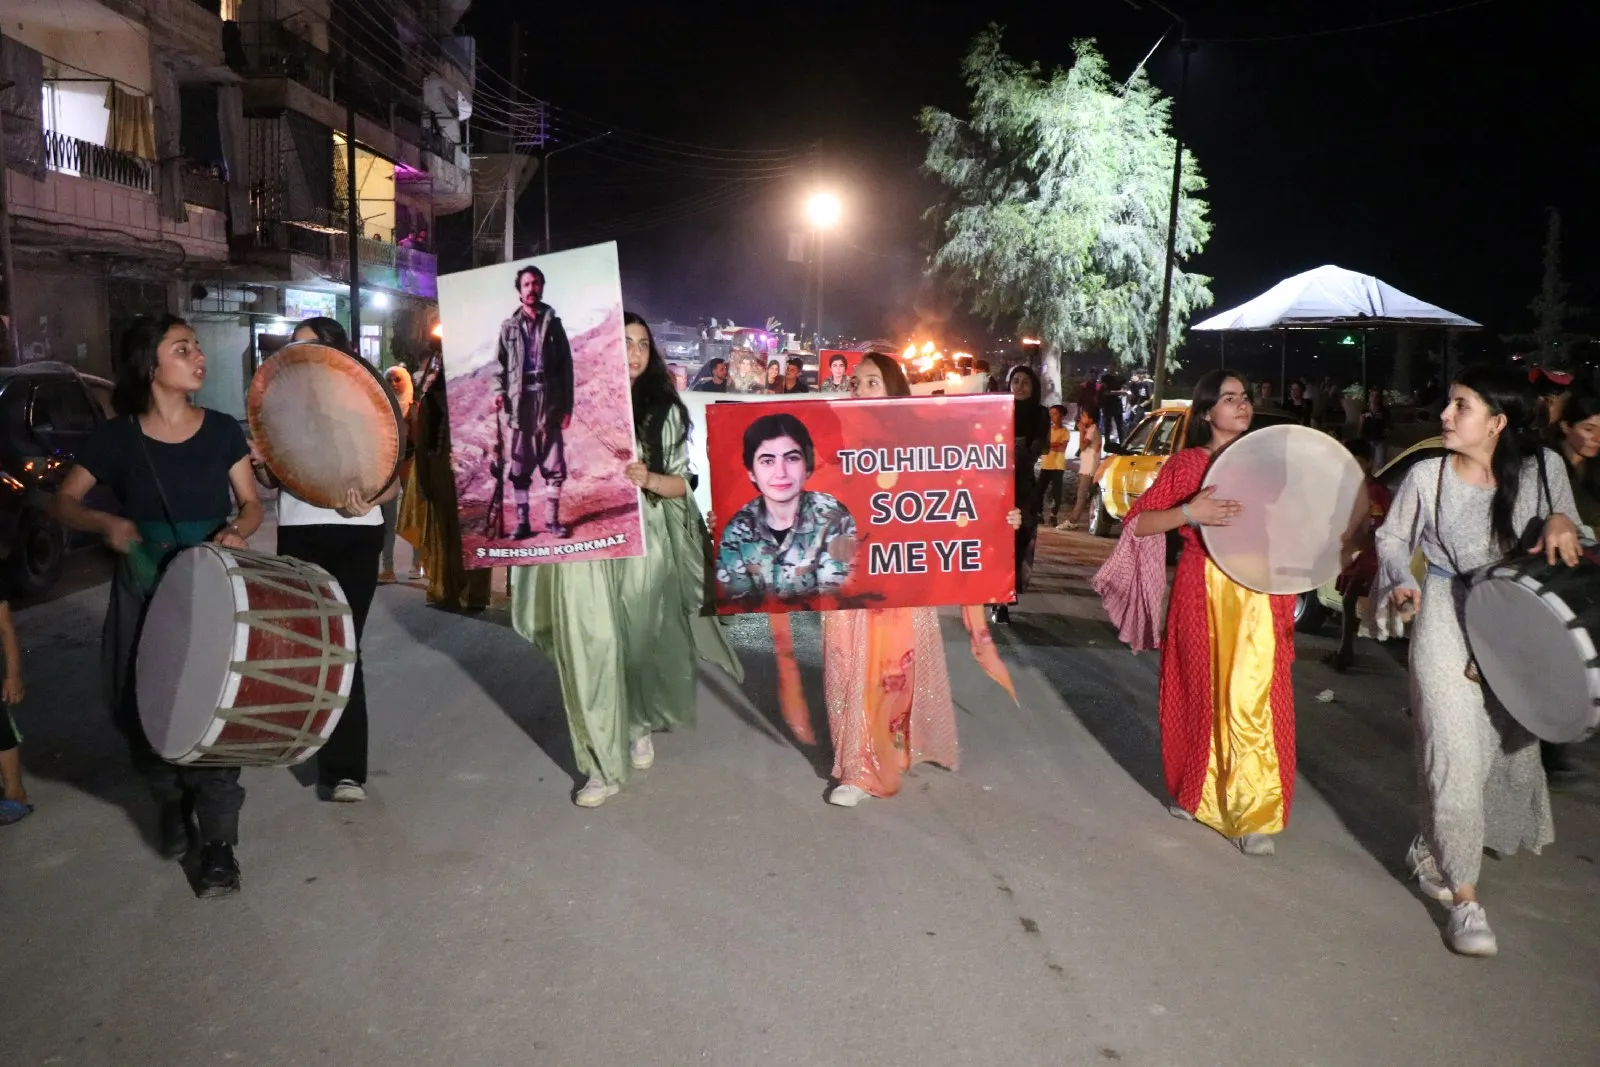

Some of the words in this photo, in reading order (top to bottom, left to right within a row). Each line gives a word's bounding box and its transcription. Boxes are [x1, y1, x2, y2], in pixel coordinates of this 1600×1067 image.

[838, 444, 1007, 475] TOLHILDAN
[870, 489, 978, 525] SOZA
[554, 533, 626, 555] KORKMAZ
[869, 542, 928, 575] ME
[932, 540, 982, 572] YE
